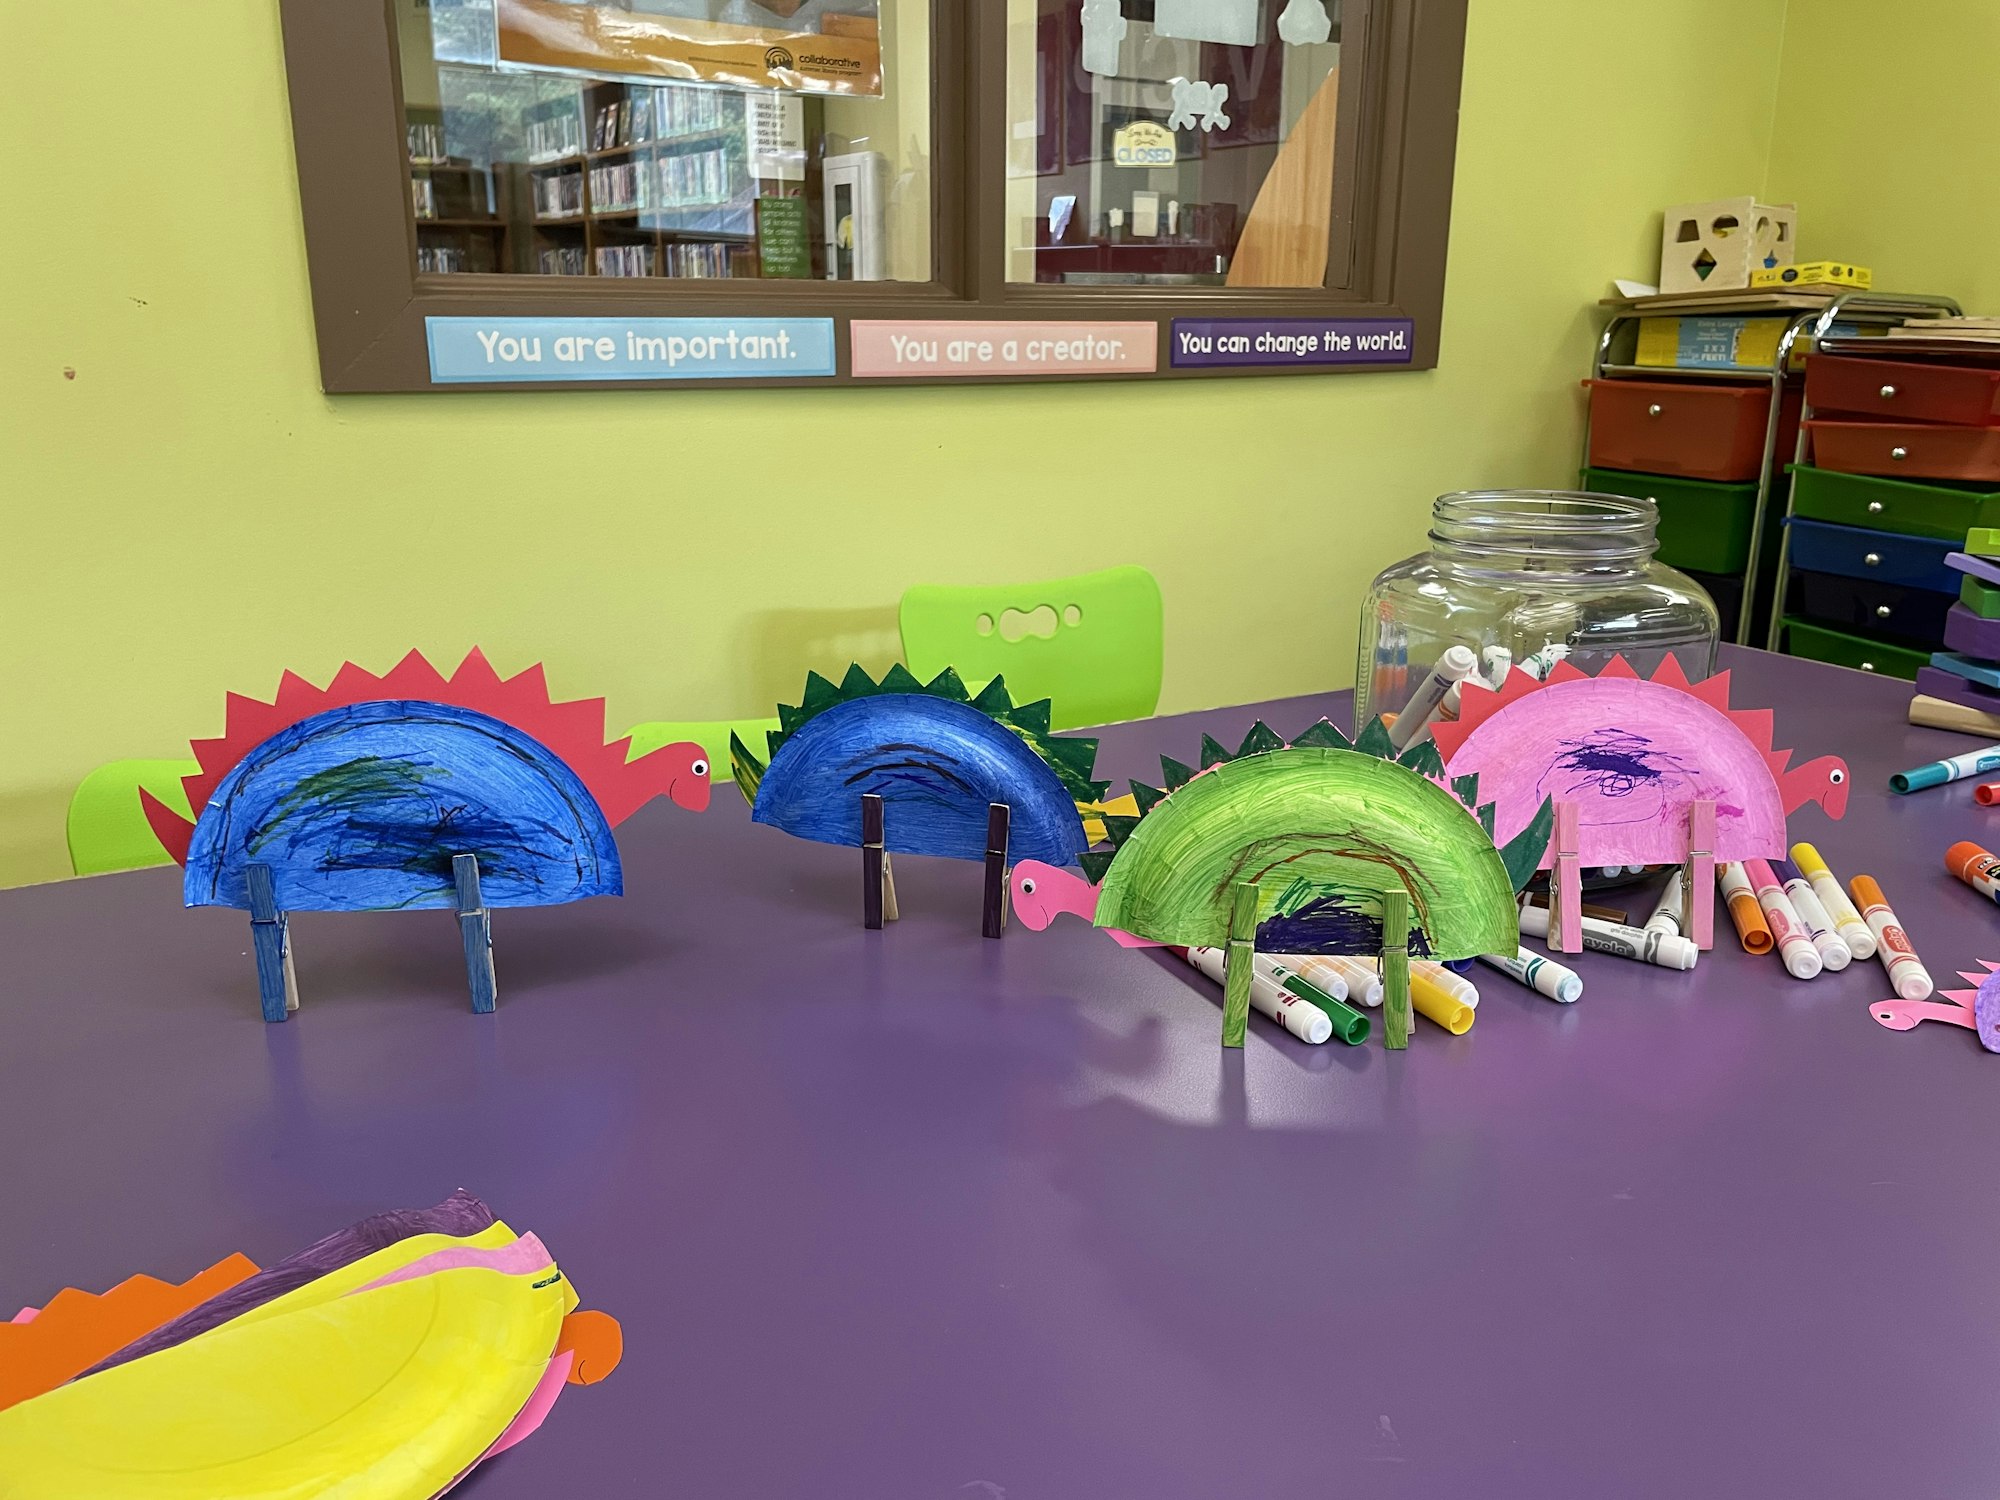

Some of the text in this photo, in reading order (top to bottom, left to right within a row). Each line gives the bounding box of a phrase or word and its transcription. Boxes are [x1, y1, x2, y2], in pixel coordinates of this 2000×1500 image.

[799, 54, 861, 69] collaborative
[1117, 147, 1173, 163] CLOSED
[476, 329, 797, 367] You are important.
[890, 334, 1127, 363] You are a creator.
[1178, 330, 1408, 357] You can change the world.
[1580, 934, 1627, 955] ayola
